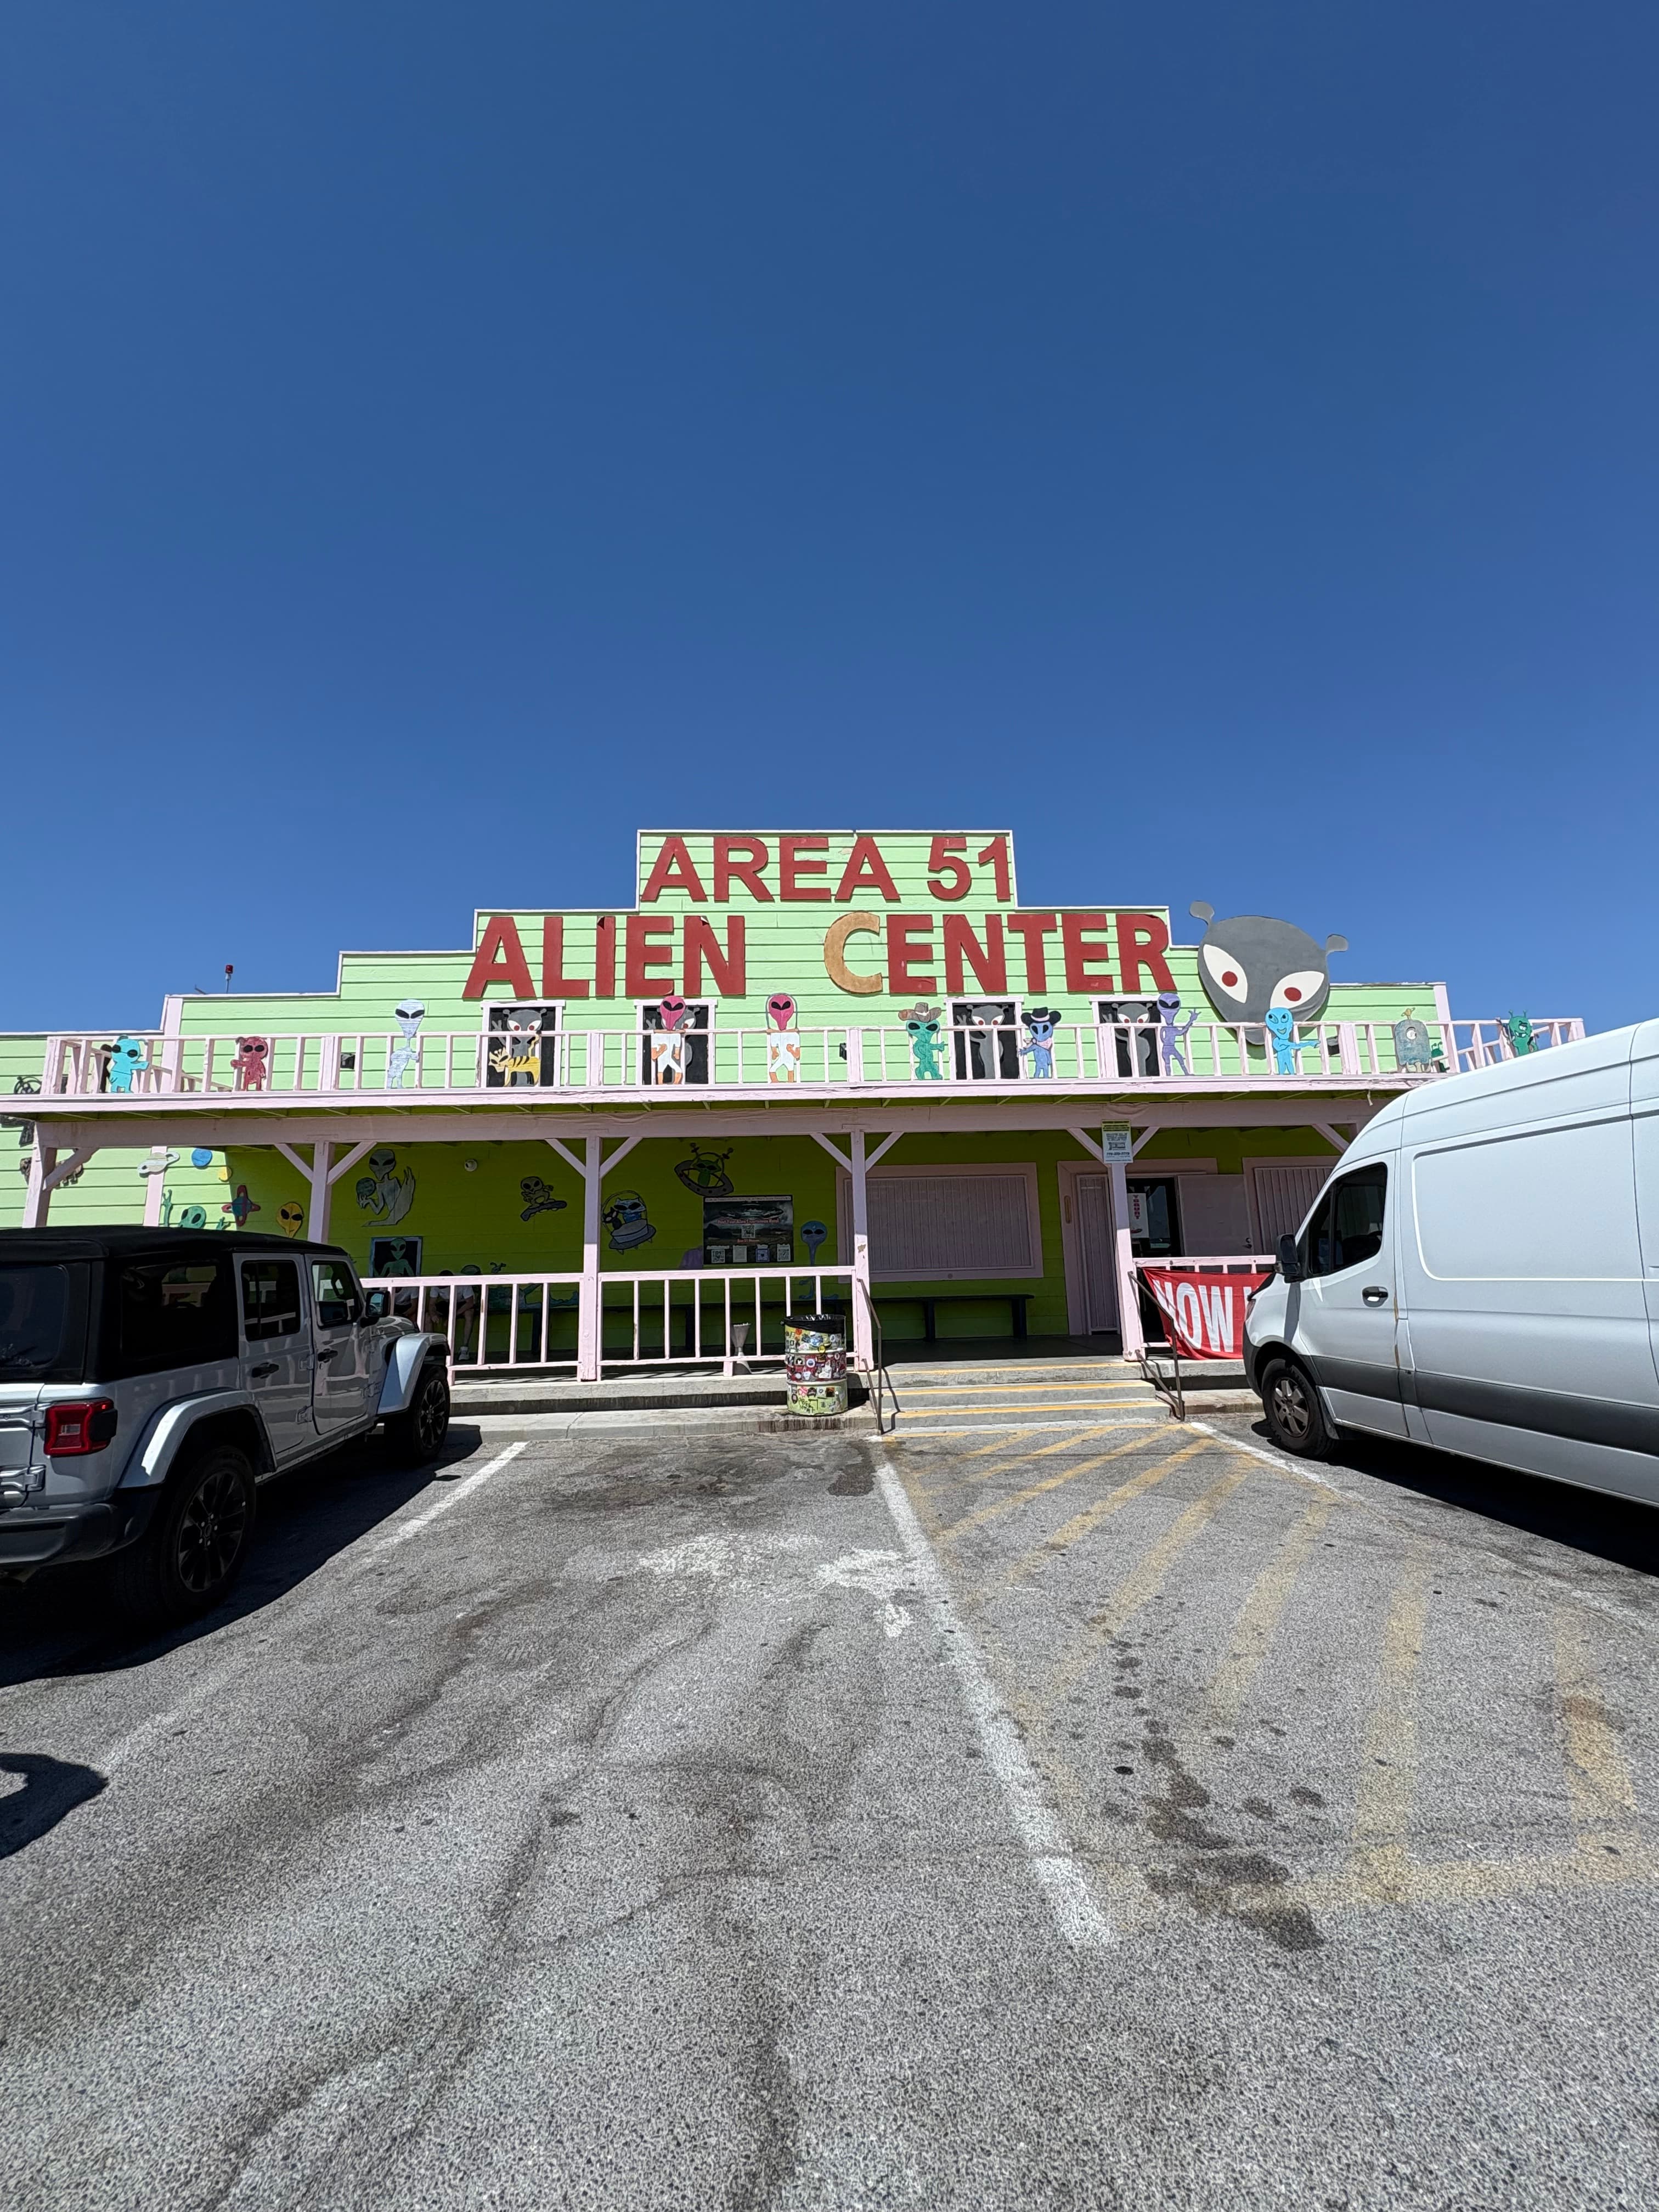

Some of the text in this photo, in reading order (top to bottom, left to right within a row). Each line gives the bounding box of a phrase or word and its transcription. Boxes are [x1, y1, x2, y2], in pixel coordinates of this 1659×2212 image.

[640, 836, 1011, 902] AREA 51
[462, 911, 1178, 1000] ALIEN CENTER
[1152, 1279, 1234, 1353] NOW
